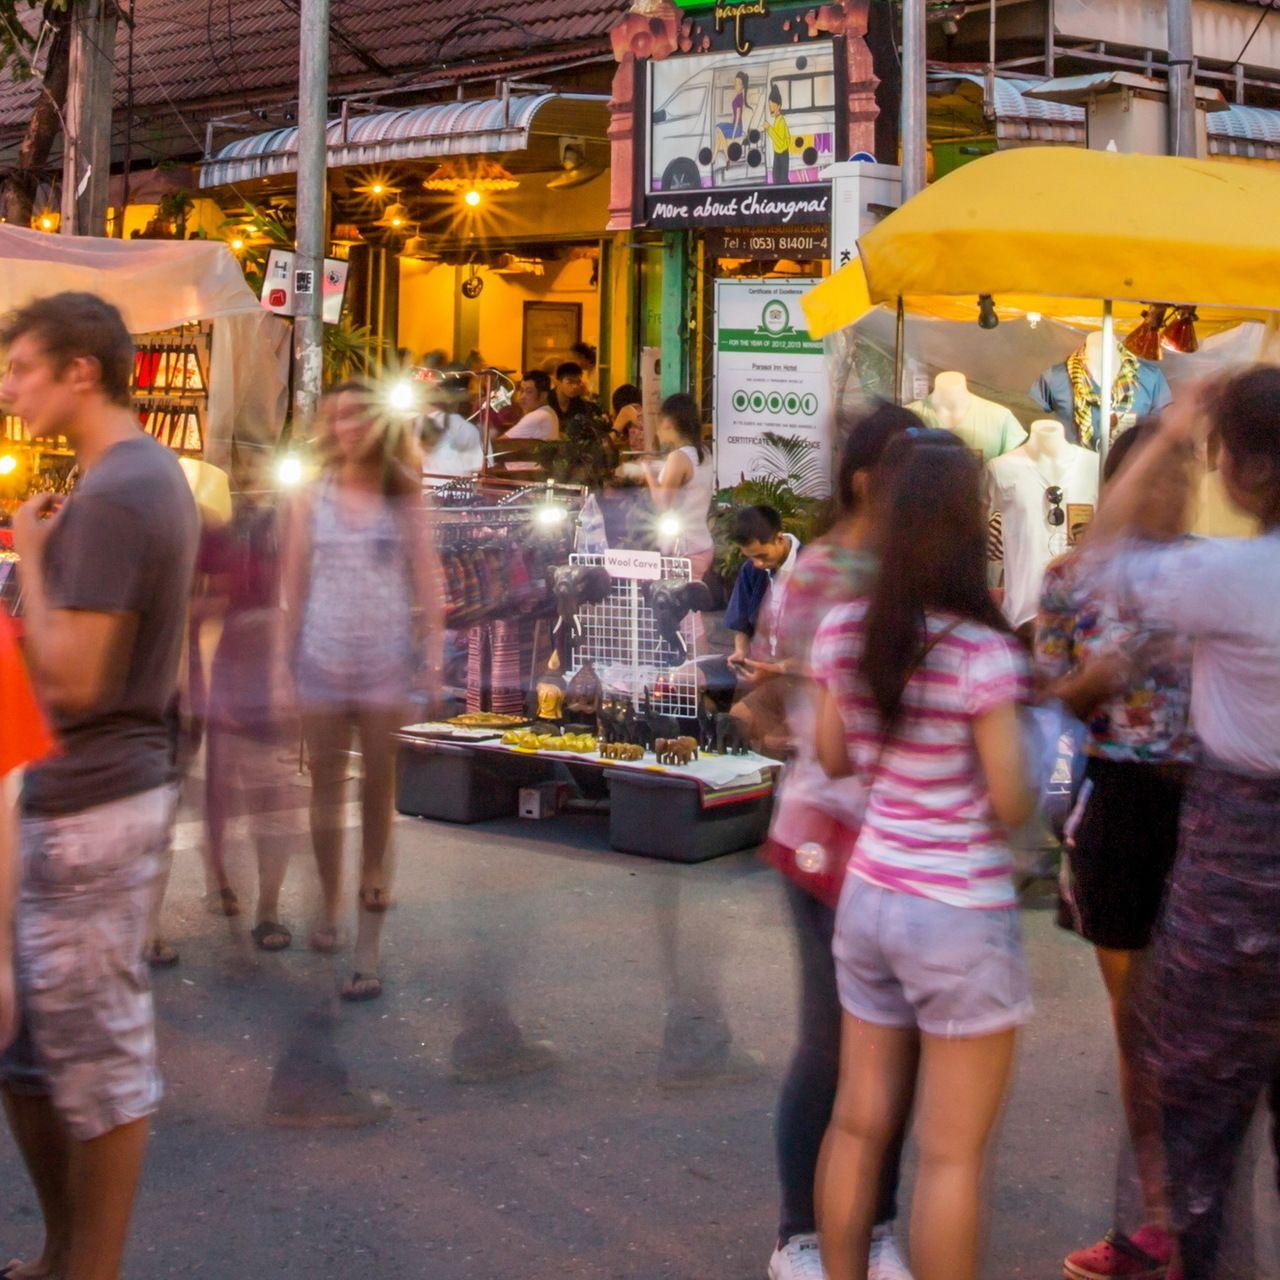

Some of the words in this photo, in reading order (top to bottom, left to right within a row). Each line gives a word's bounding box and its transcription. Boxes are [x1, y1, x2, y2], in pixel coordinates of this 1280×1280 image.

[693, 196, 737, 217] about
[740, 191, 828, 223] Chiangmai
[723, 237, 739, 249] Tel
[749, 237, 775, 250] (053)
